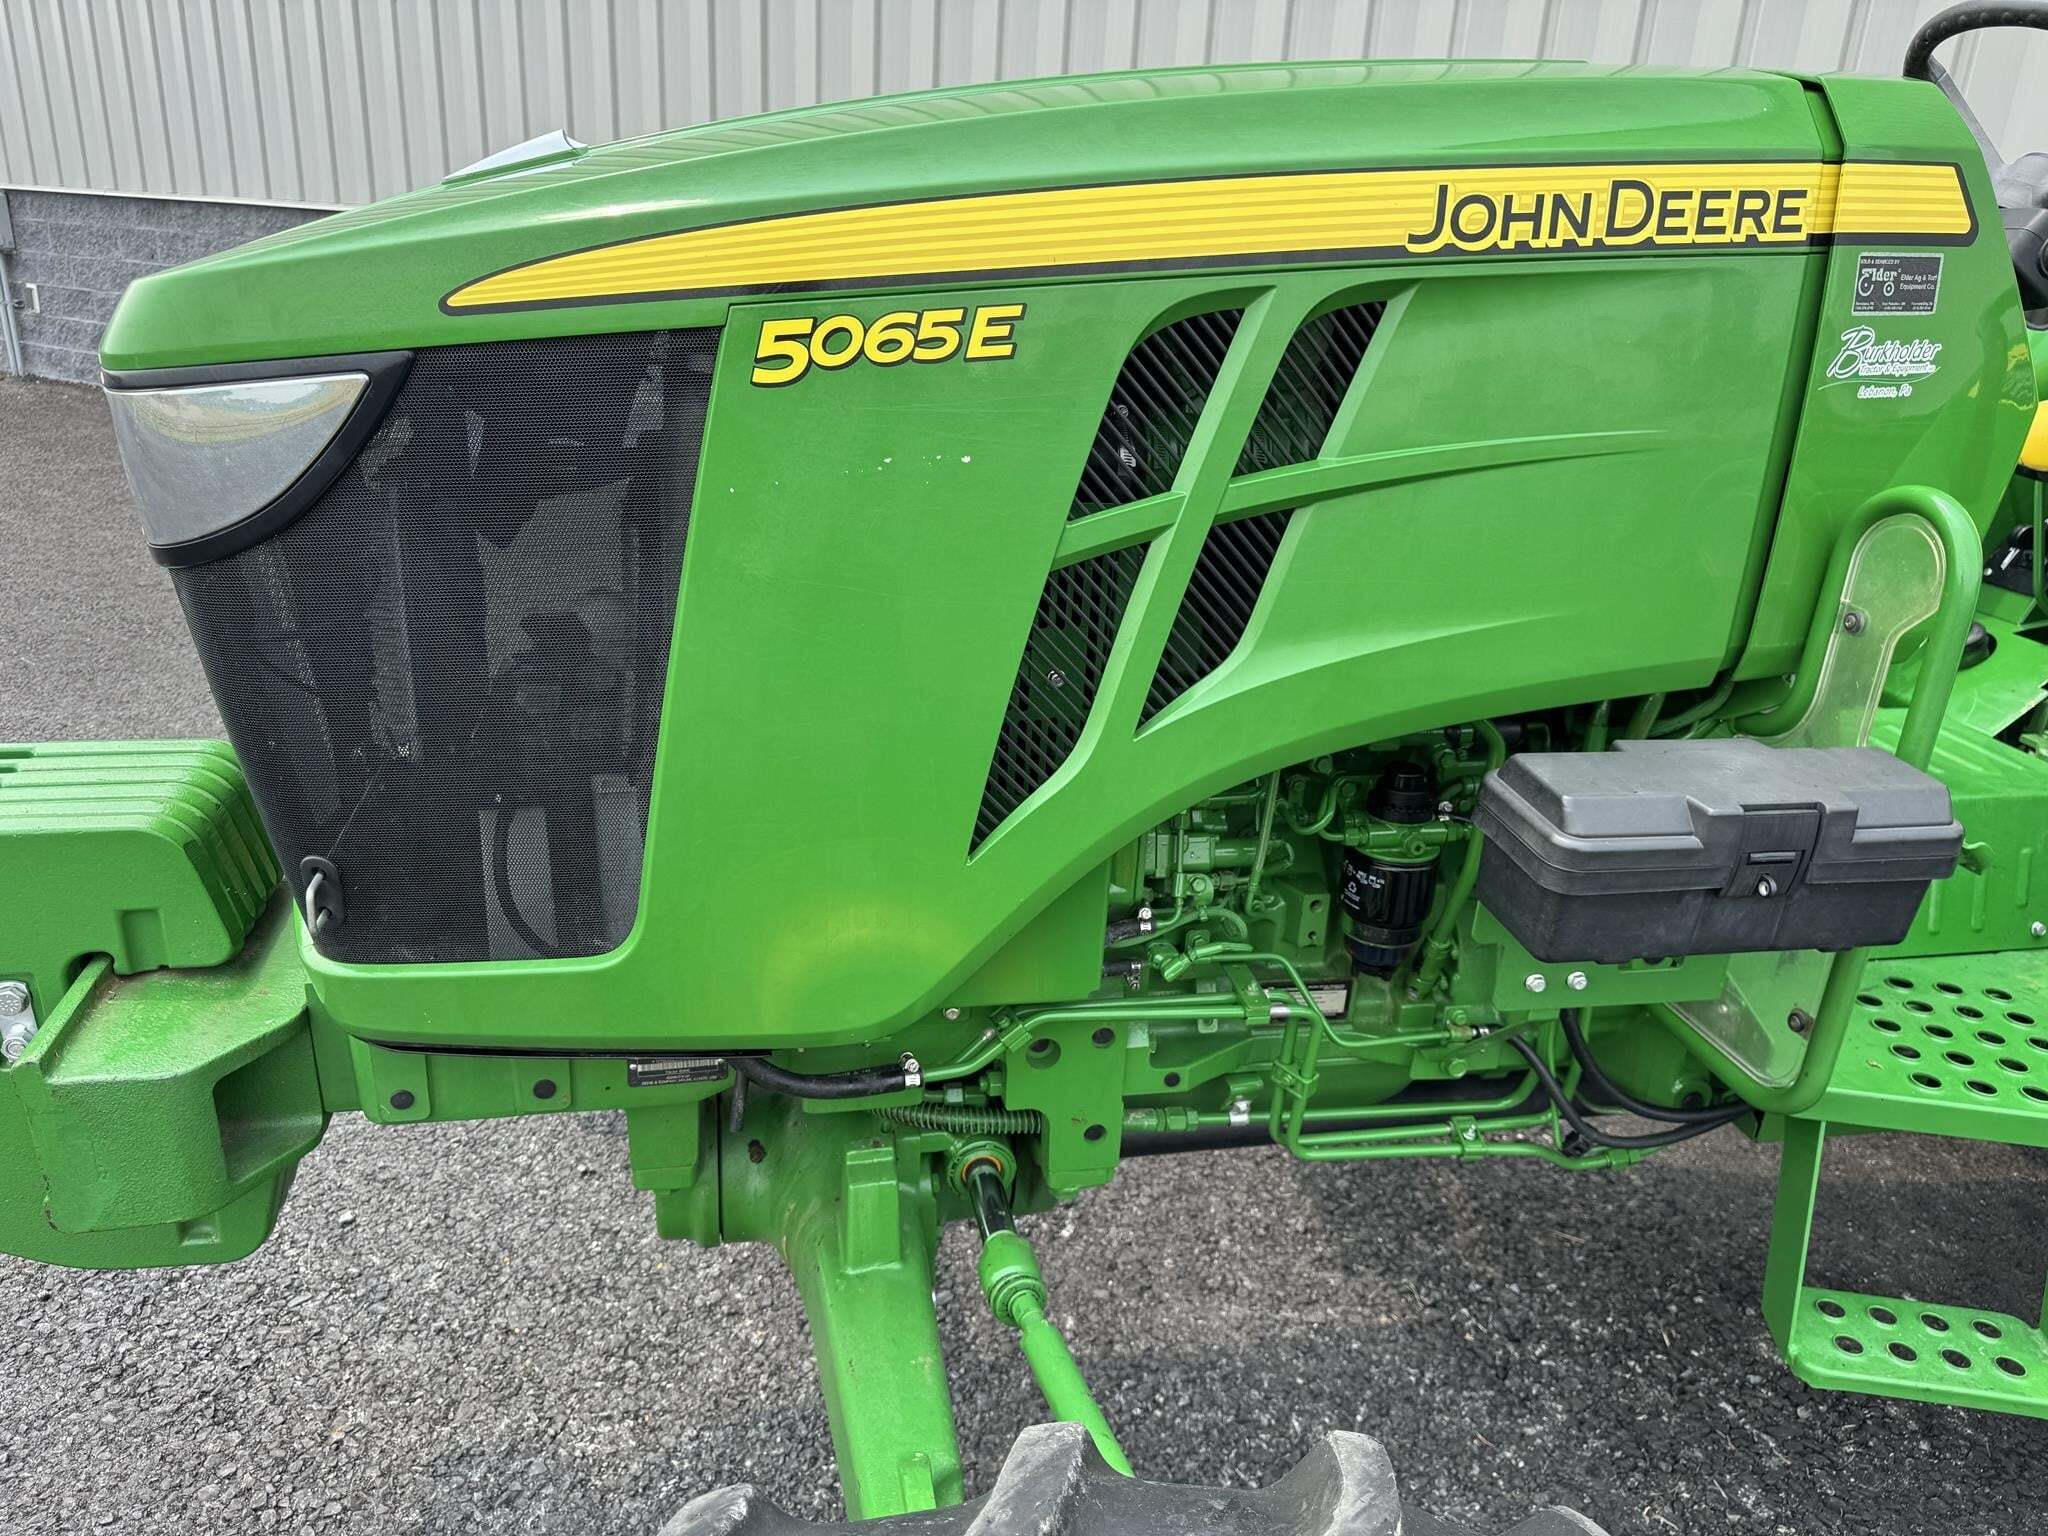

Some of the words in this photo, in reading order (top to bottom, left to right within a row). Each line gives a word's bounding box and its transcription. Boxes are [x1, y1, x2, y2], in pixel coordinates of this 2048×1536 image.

[1406, 184, 1593, 247] JOHN
[1604, 179, 1809, 238] DEERE
[1899, 282, 1927, 291] Equipment
[1914, 274, 1922, 283] Ag
[1826, 325, 1943, 379] Burkholder
[1891, 361, 1929, 377] Equipment
